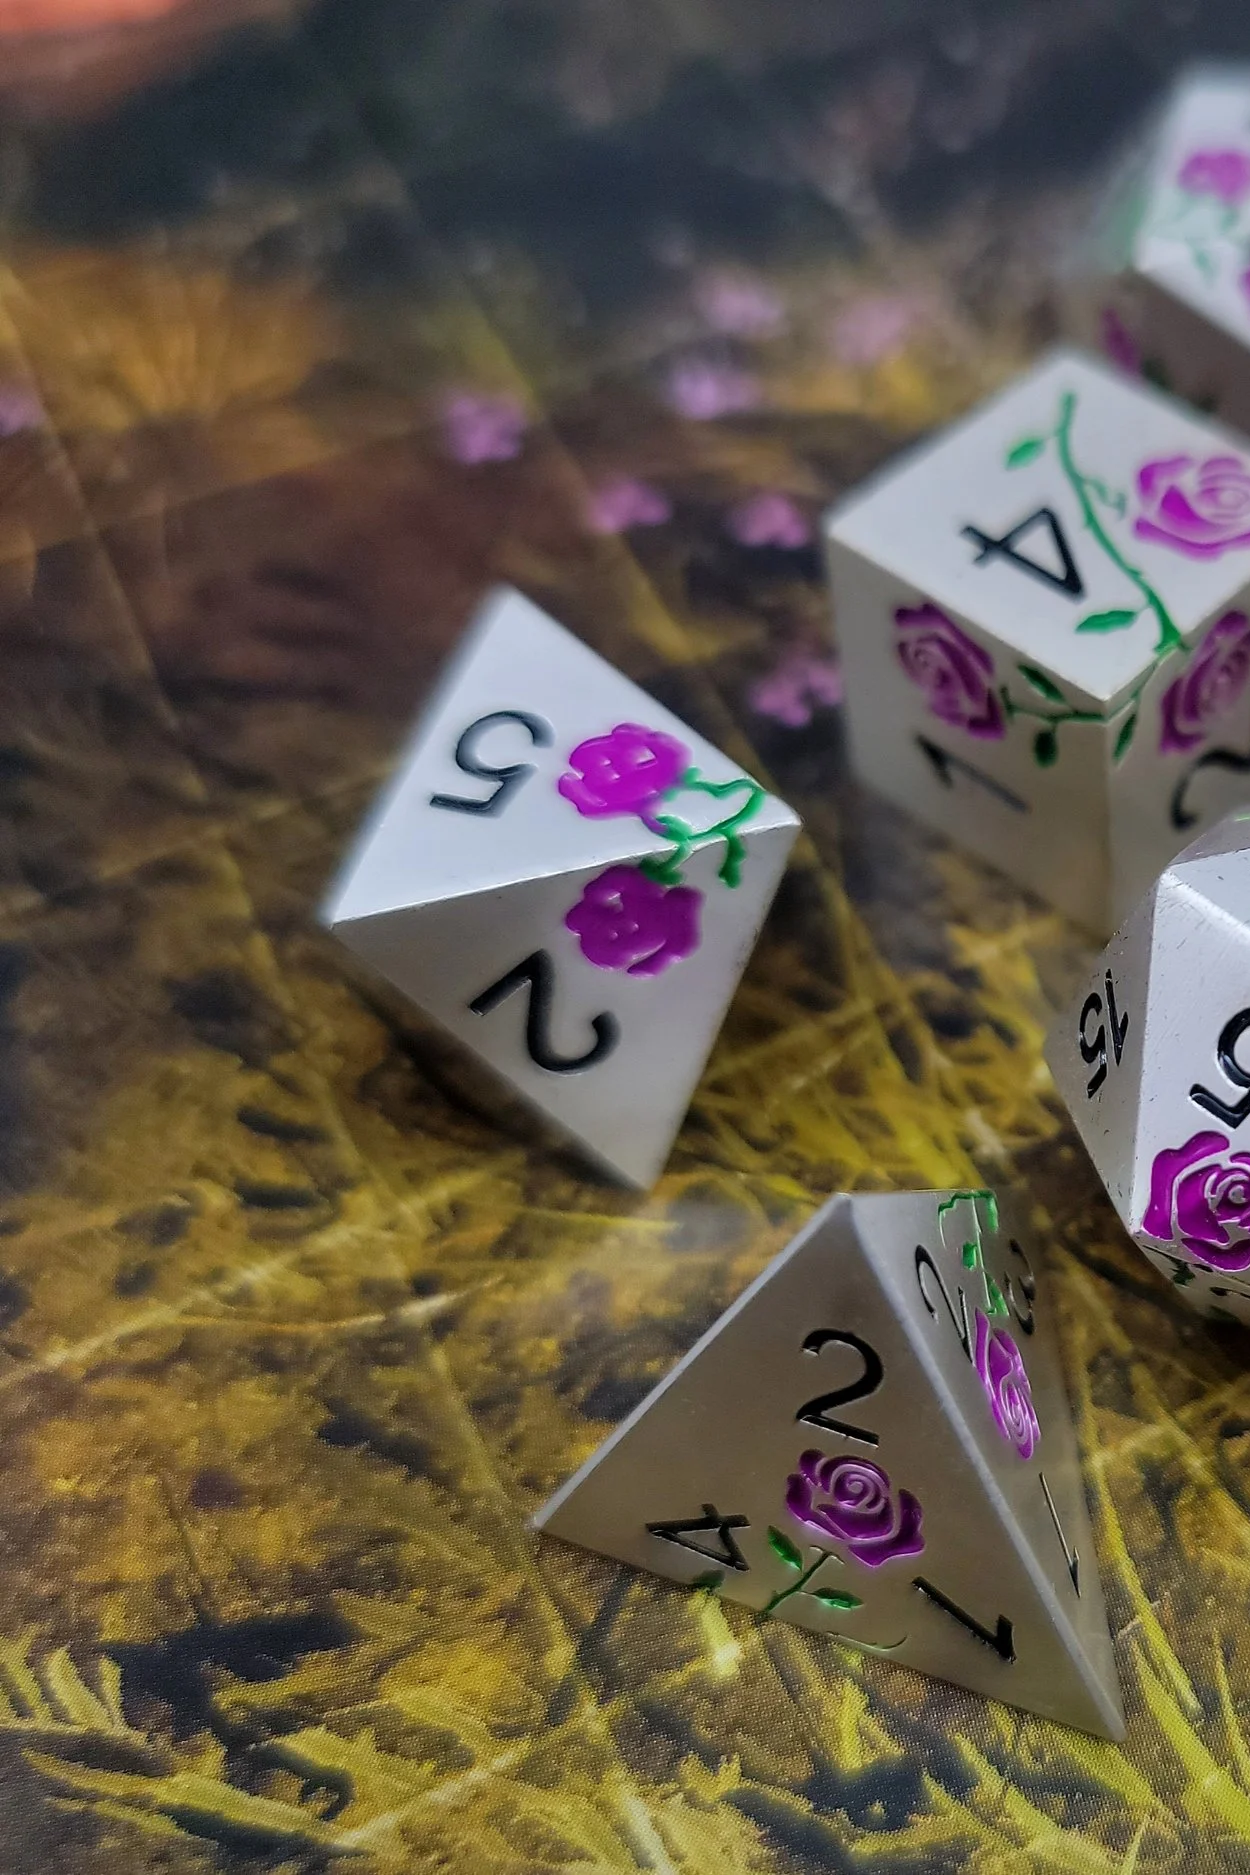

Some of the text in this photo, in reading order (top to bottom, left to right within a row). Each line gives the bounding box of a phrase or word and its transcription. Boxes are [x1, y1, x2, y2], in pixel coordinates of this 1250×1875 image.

[959, 507, 1085, 600] 4
[430, 710, 556, 818] 5
[917, 733, 1030, 813] 1
[469, 949, 620, 1074] 2
[1079, 969, 1129, 1100] 15
[915, 1245, 974, 1362] 2
[1004, 1239, 1037, 1336] 3
[796, 1328, 884, 1447] 2
[645, 1504, 750, 1572] 4
[1039, 1472, 1082, 1599] 1
[911, 1577, 1017, 1664] 1
